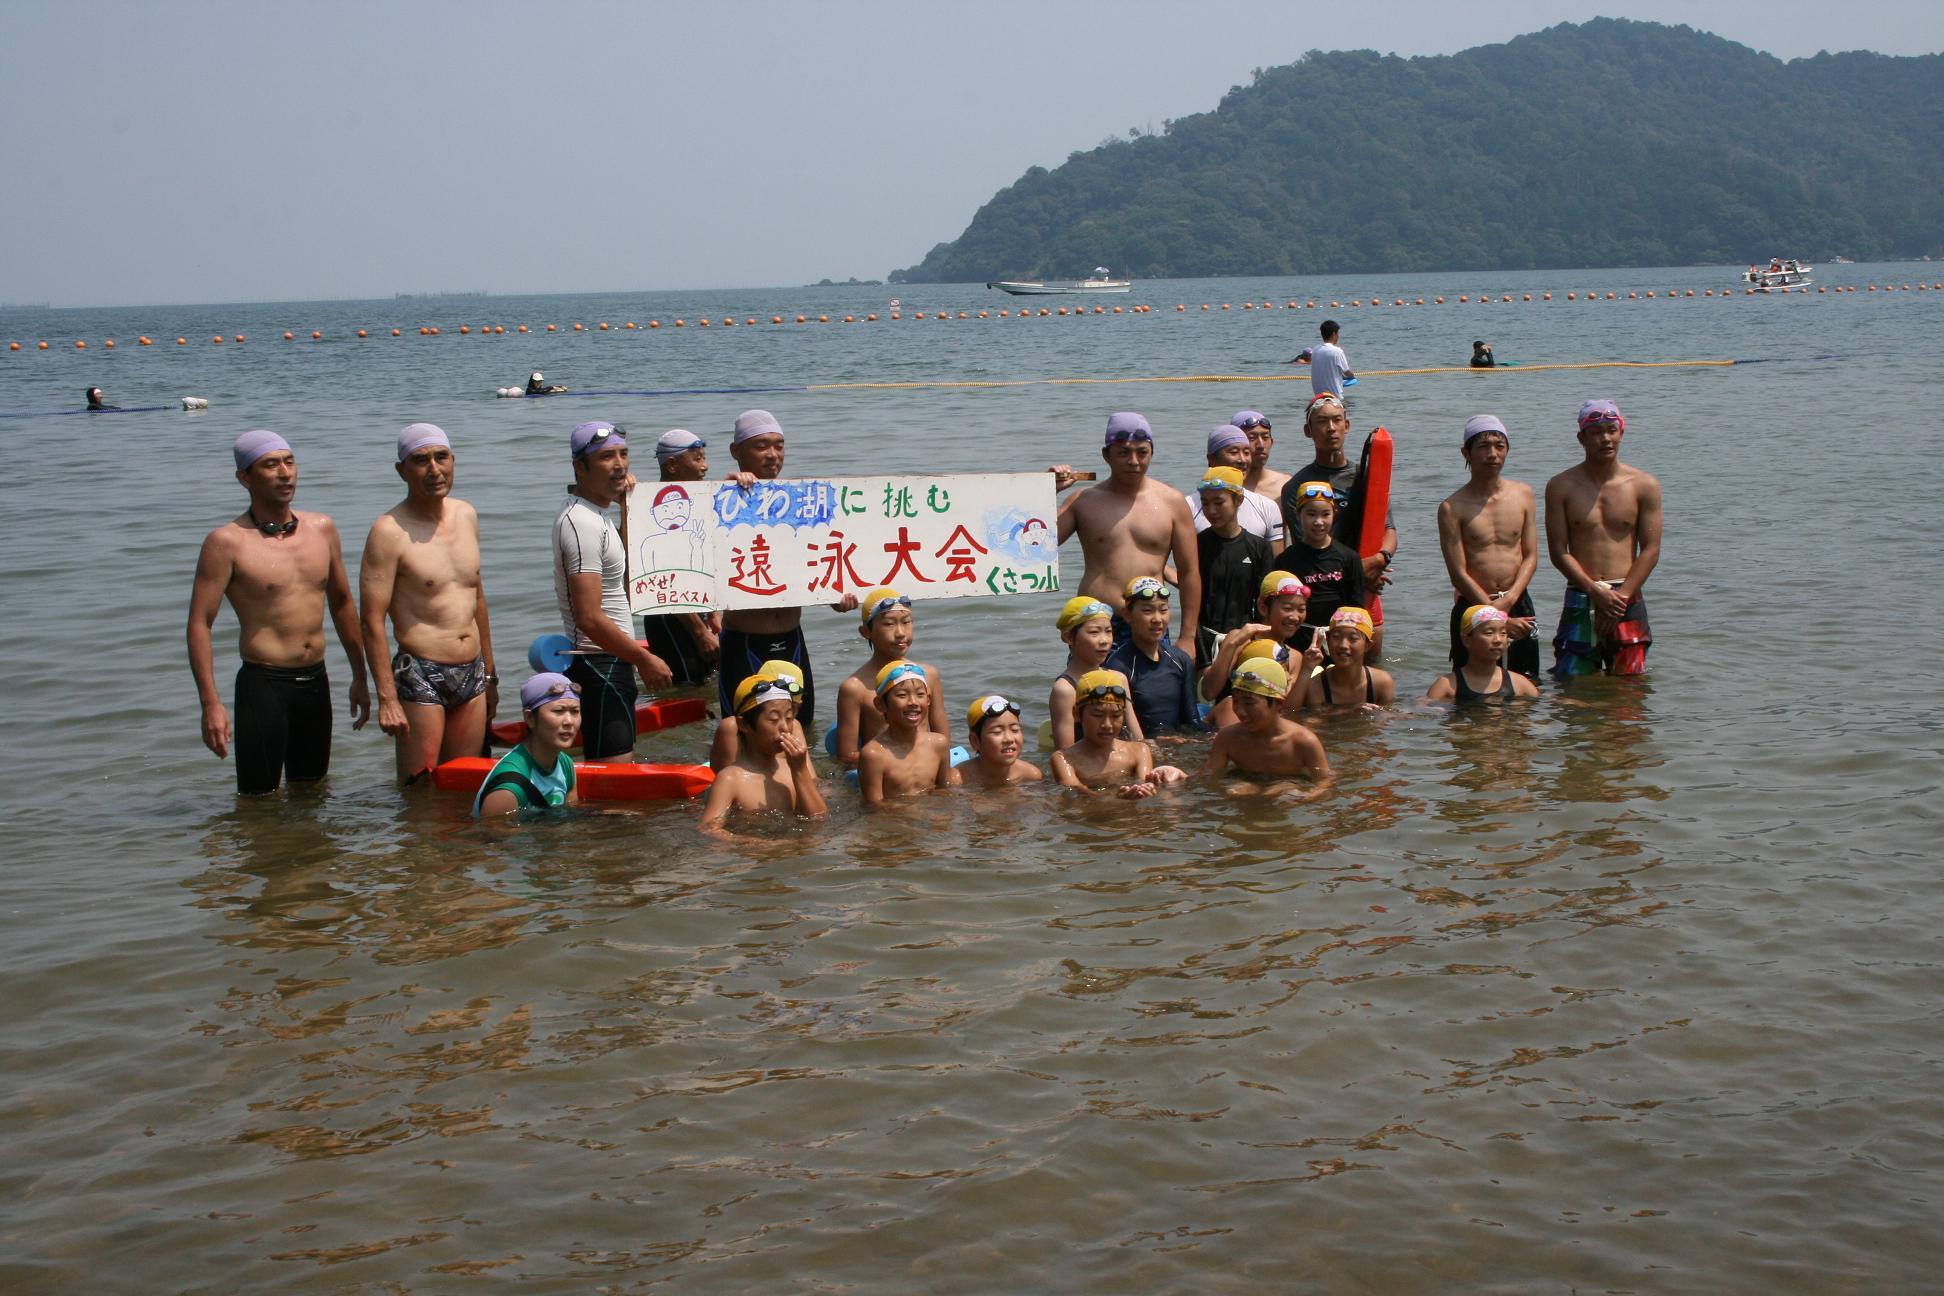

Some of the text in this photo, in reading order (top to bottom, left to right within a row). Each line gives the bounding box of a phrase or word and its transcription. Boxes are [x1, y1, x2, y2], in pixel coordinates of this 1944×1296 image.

[728, 525, 988, 596] 遠泳大会
[986, 565, 1059, 596] くさつ小
